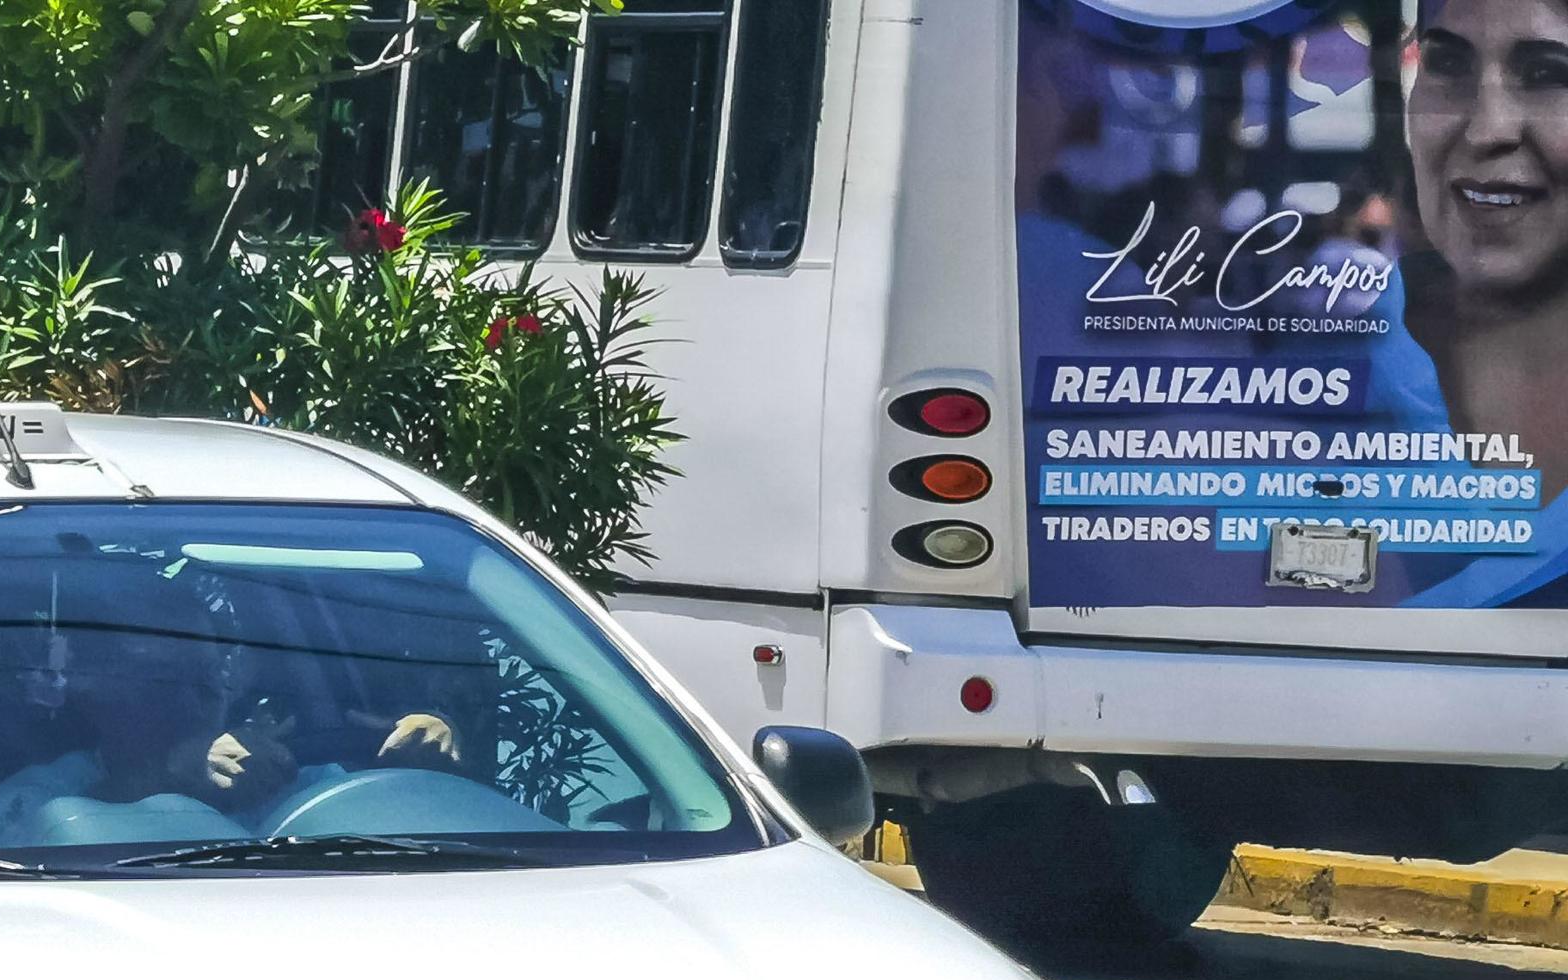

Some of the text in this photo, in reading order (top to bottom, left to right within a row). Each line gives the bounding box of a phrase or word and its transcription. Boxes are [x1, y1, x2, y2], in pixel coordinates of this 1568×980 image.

[1082, 200, 1393, 311] Lili Campos
[1083, 315, 1389, 333] PRESIDENTA MUNICIPAL DE SOLIDARIDAD
[1051, 366, 1351, 406] REALIZAMOS
[1046, 429, 1533, 467] SANEAMIENTO AMBIENTAL,
[1045, 472, 1246, 496] ELIMINANDO
[1387, 475, 1405, 497] Y
[1411, 474, 1536, 499] MACROS
[1042, 517, 1211, 541] TIRADEROS
[1221, 517, 1258, 541] EN
